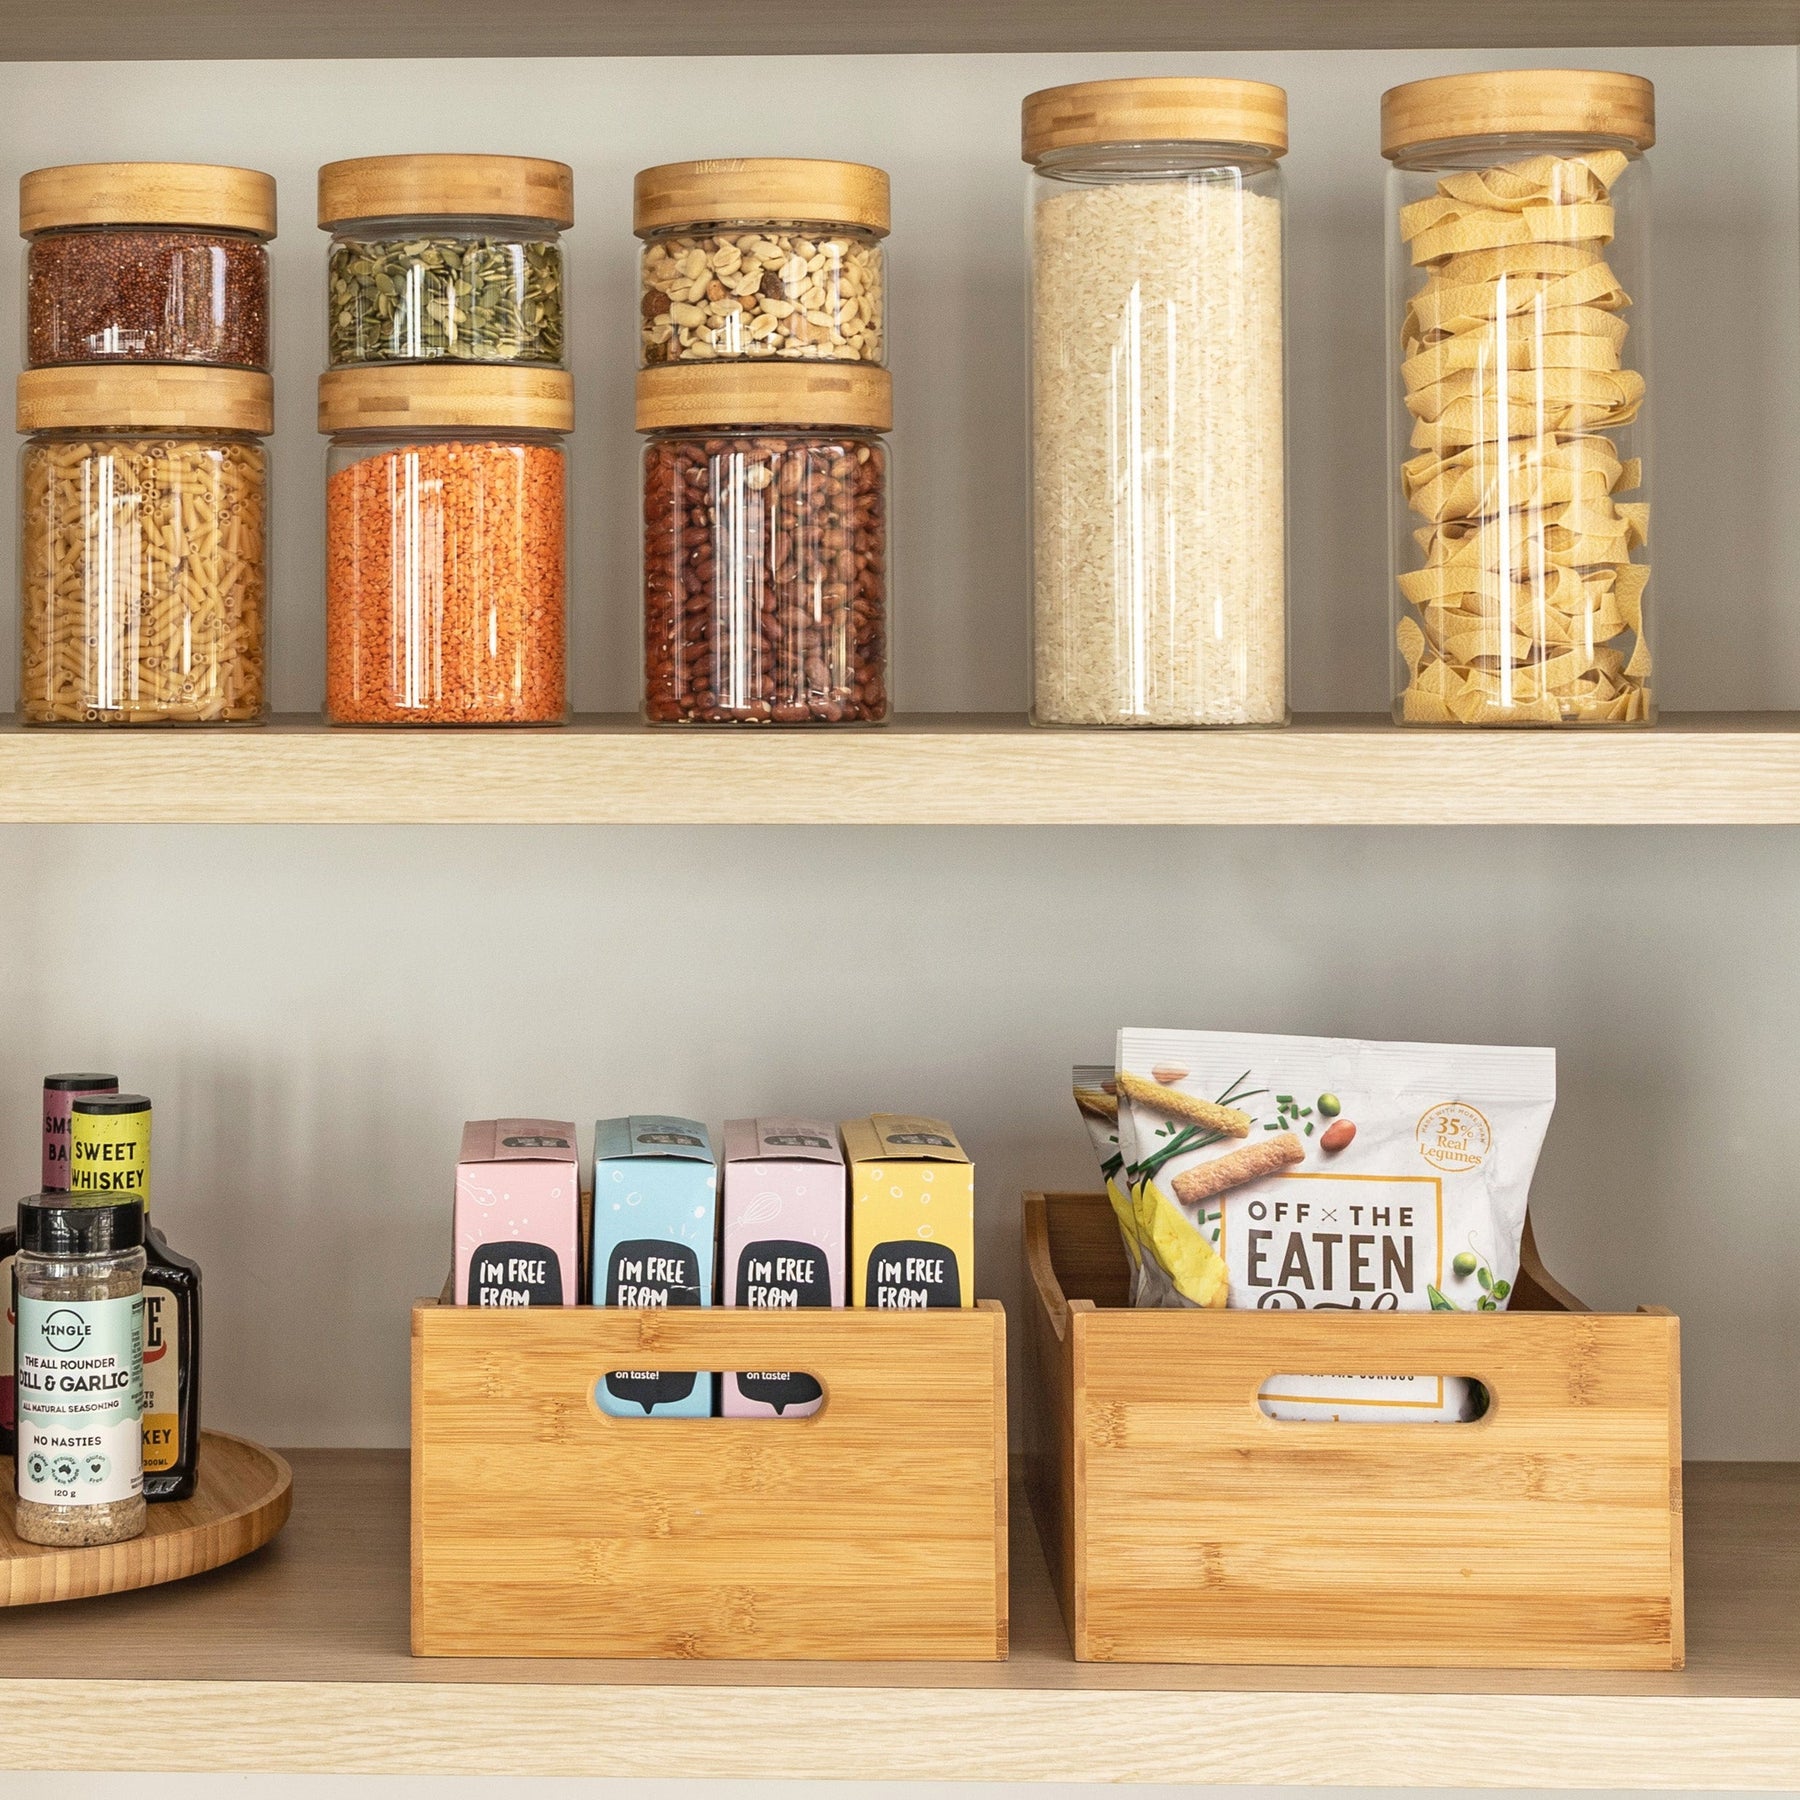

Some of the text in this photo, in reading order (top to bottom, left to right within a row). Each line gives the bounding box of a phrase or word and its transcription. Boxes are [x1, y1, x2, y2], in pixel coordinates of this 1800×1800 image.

[1436, 1117, 1474, 1138] 35%
[75, 1141, 137, 1161] SWEET
[1420, 1143, 1482, 1164] Legumes
[1437, 1135, 1468, 1151] Real
[72, 1169, 144, 1190] WHISKEY
[1248, 1201, 1413, 1227] OFF THE
[479, 1258, 547, 1284] I'M FREE
[618, 1257, 685, 1283] I'M FREE
[748, 1257, 815, 1283] I'M FREE
[877, 1258, 944, 1284] I'M FREE
[1248, 1229, 1413, 1293] EATEN
[479, 1287, 530, 1306] FROM
[618, 1285, 668, 1307] FROM
[748, 1286, 798, 1307] FROM
[877, 1286, 928, 1308] FROM
[41, 1325, 92, 1336] MINGLE
[25, 1355, 115, 1370] THE ALL ROUNDER
[20, 1369, 129, 1392] DILL & GARLIC
[615, 1371, 659, 1380] on taste!
[746, 1371, 790, 1381] on taste!
[23, 1400, 119, 1413] ALL NATURAL SEASONING
[34, 1435, 101, 1447] NO NASTIES
